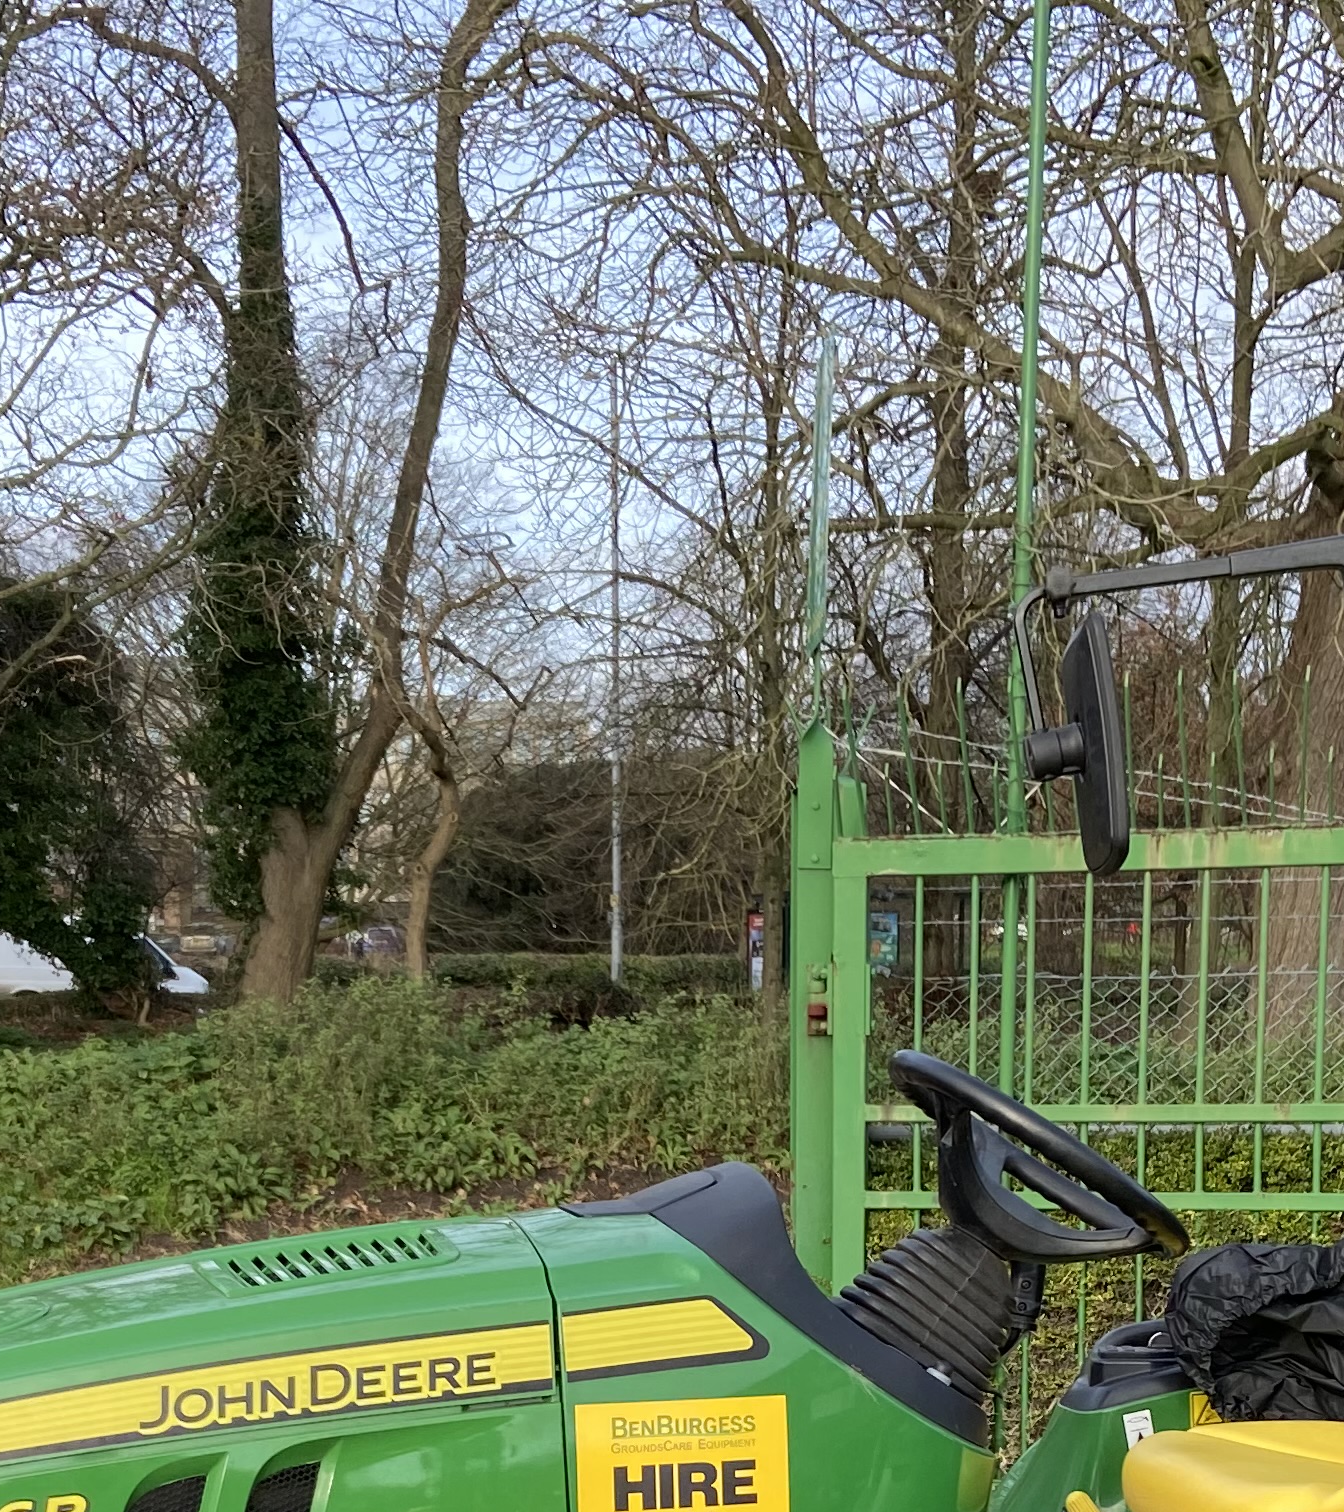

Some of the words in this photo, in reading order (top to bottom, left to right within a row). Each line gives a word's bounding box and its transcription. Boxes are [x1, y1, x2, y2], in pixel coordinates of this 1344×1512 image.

[139, 1375, 297, 1430] JOHN
[309, 1351, 498, 1407] DEERE
[612, 1459, 758, 1512] HIRE
